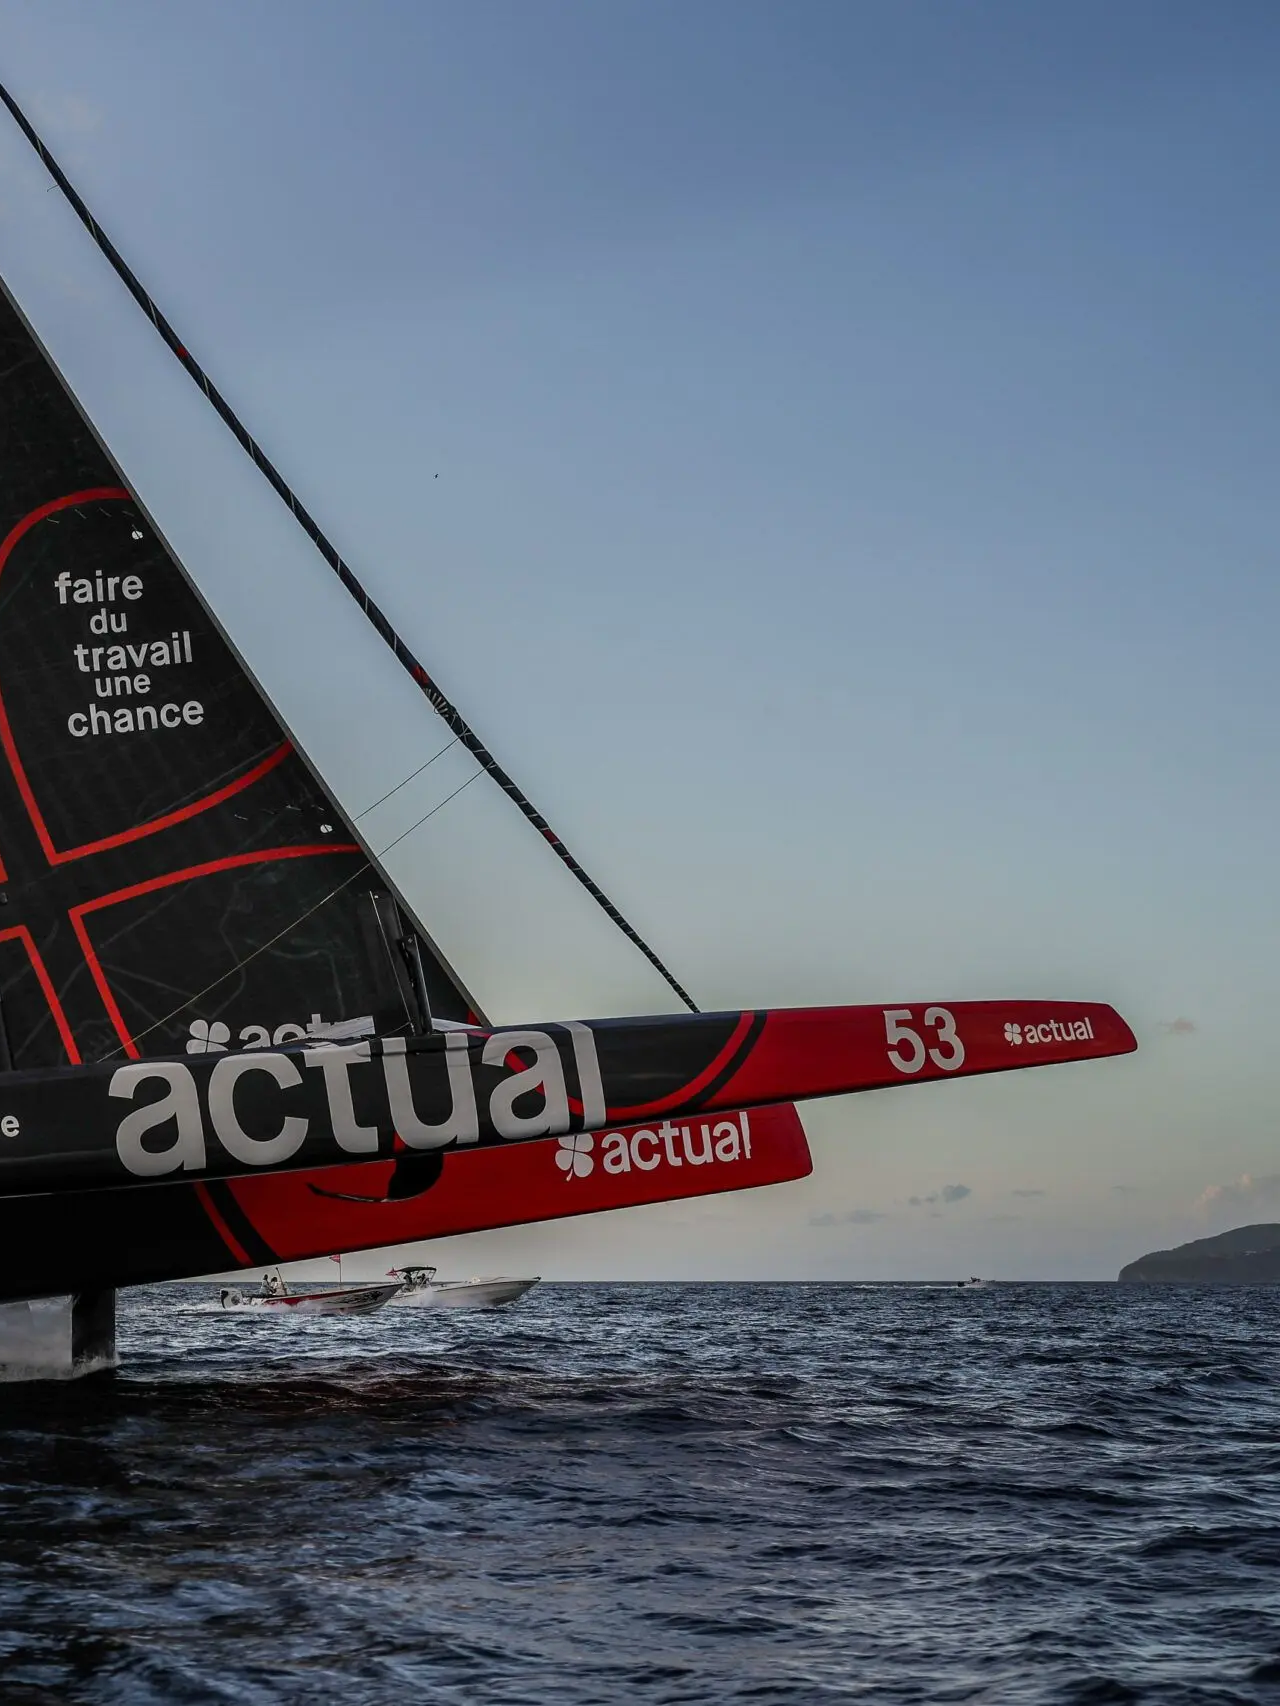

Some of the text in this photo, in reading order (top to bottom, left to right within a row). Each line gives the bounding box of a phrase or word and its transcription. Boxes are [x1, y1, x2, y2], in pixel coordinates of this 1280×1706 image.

[54, 570, 144, 604] faire
[89, 608, 128, 635] du
[73, 631, 193, 673] travail
[94, 673, 151, 698] une
[67, 700, 205, 737] chance
[882, 1007, 965, 1074] 53
[1023, 1016, 1094, 1044] actual
[108, 1021, 606, 1176] actual
[601, 1111, 752, 1174] actual
